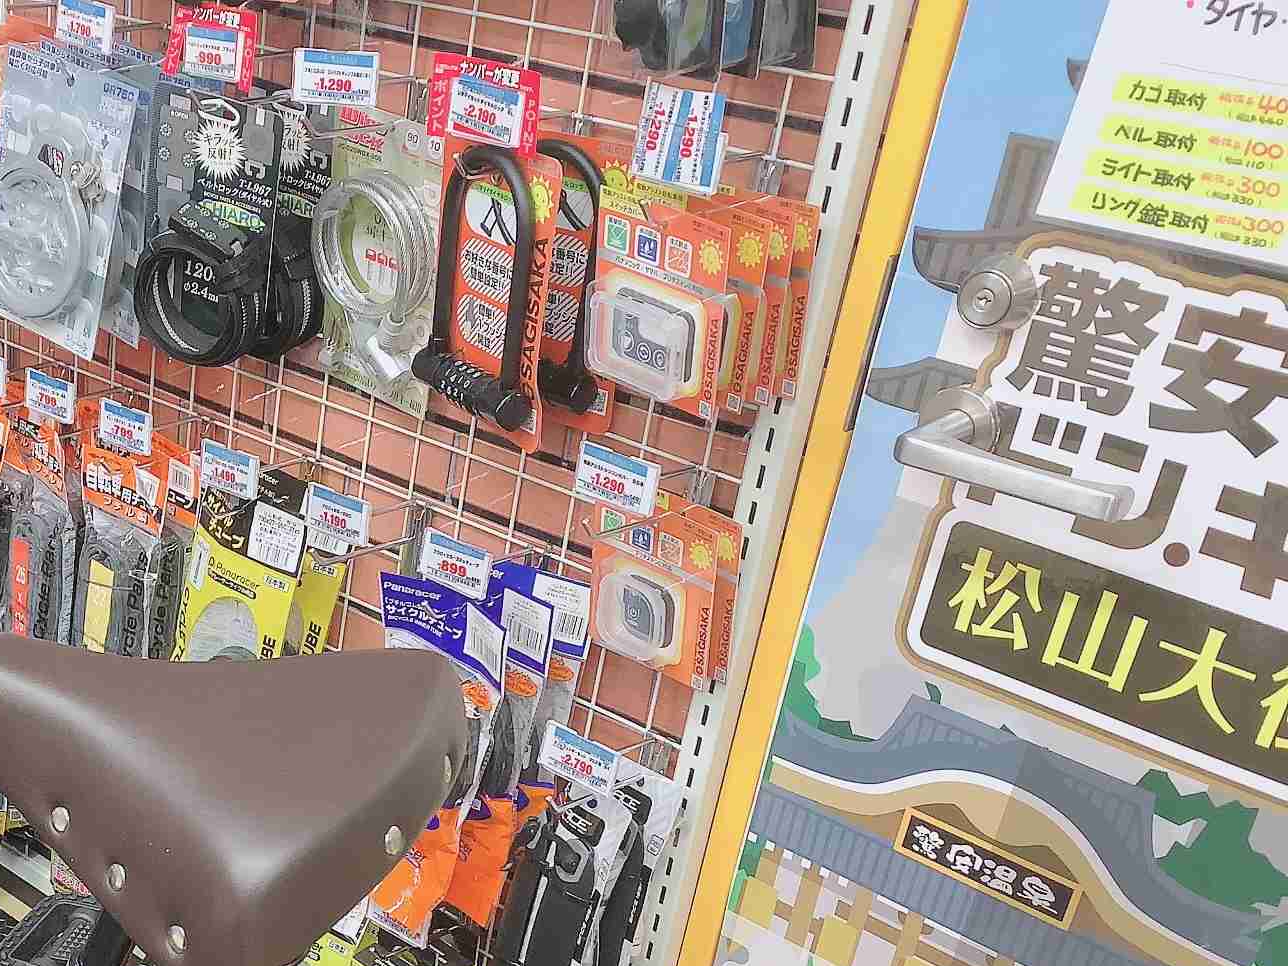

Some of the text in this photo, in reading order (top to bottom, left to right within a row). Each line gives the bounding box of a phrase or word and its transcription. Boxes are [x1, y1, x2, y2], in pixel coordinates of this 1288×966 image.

[520, 99, 537, 154] POINT
[1004, 260, 1288, 459] 驚安
[383, 581, 442, 602] Panaracer
[439, 558, 468, 579] 899
[948, 547, 1288, 750] 松山大
